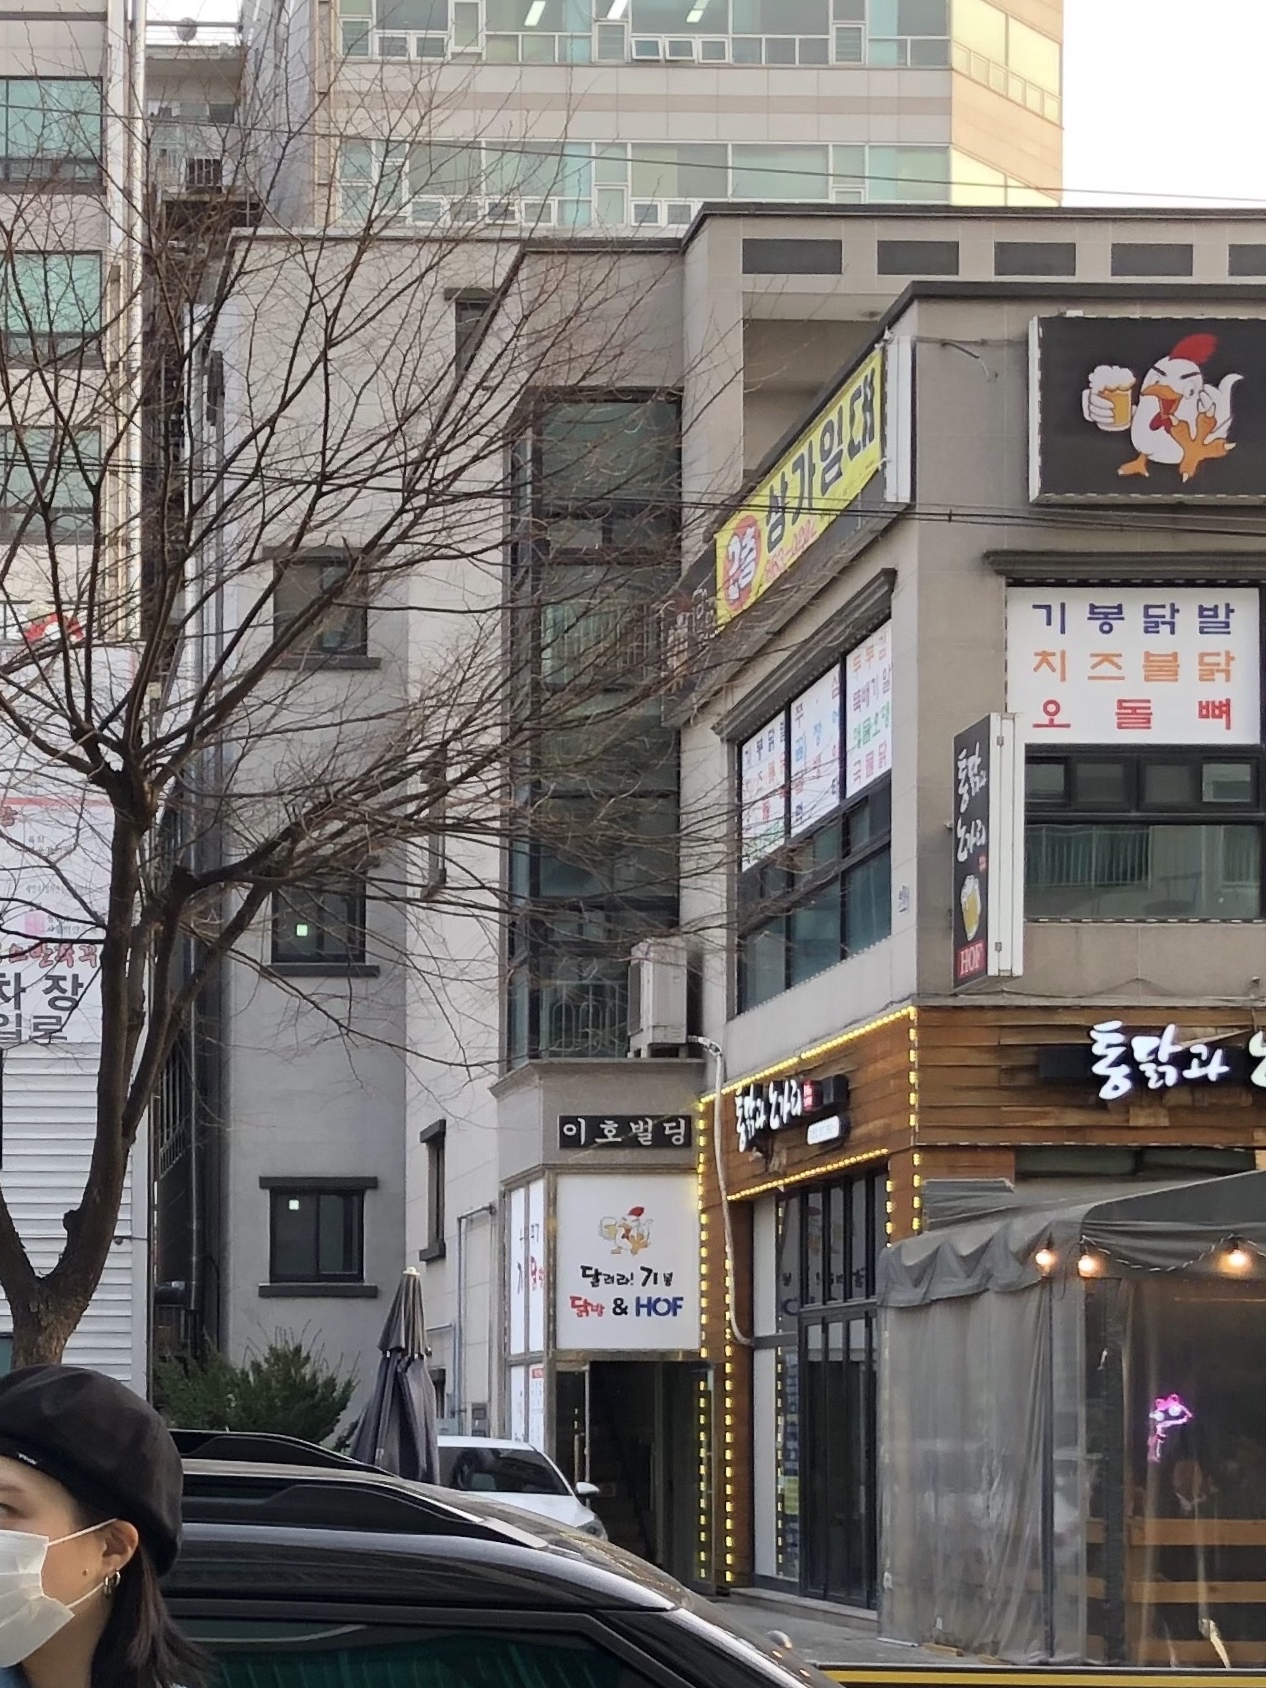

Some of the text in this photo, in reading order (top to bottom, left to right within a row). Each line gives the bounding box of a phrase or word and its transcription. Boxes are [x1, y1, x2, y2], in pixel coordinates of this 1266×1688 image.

[766, 367, 875, 553] 상가임대
[1033, 602, 1235, 635] 기봉닭발
[1033, 650, 1236, 683] 치즈불닭
[1033, 699, 1233, 731] 오돌뼈
[960, 944, 982, 976] HOF
[1090, 1020, 1230, 1100] 통닭과
[563, 1118, 685, 1146] 이호빌딩
[612, 1297, 629, 1316] &
[635, 1296, 684, 1317] HOF
